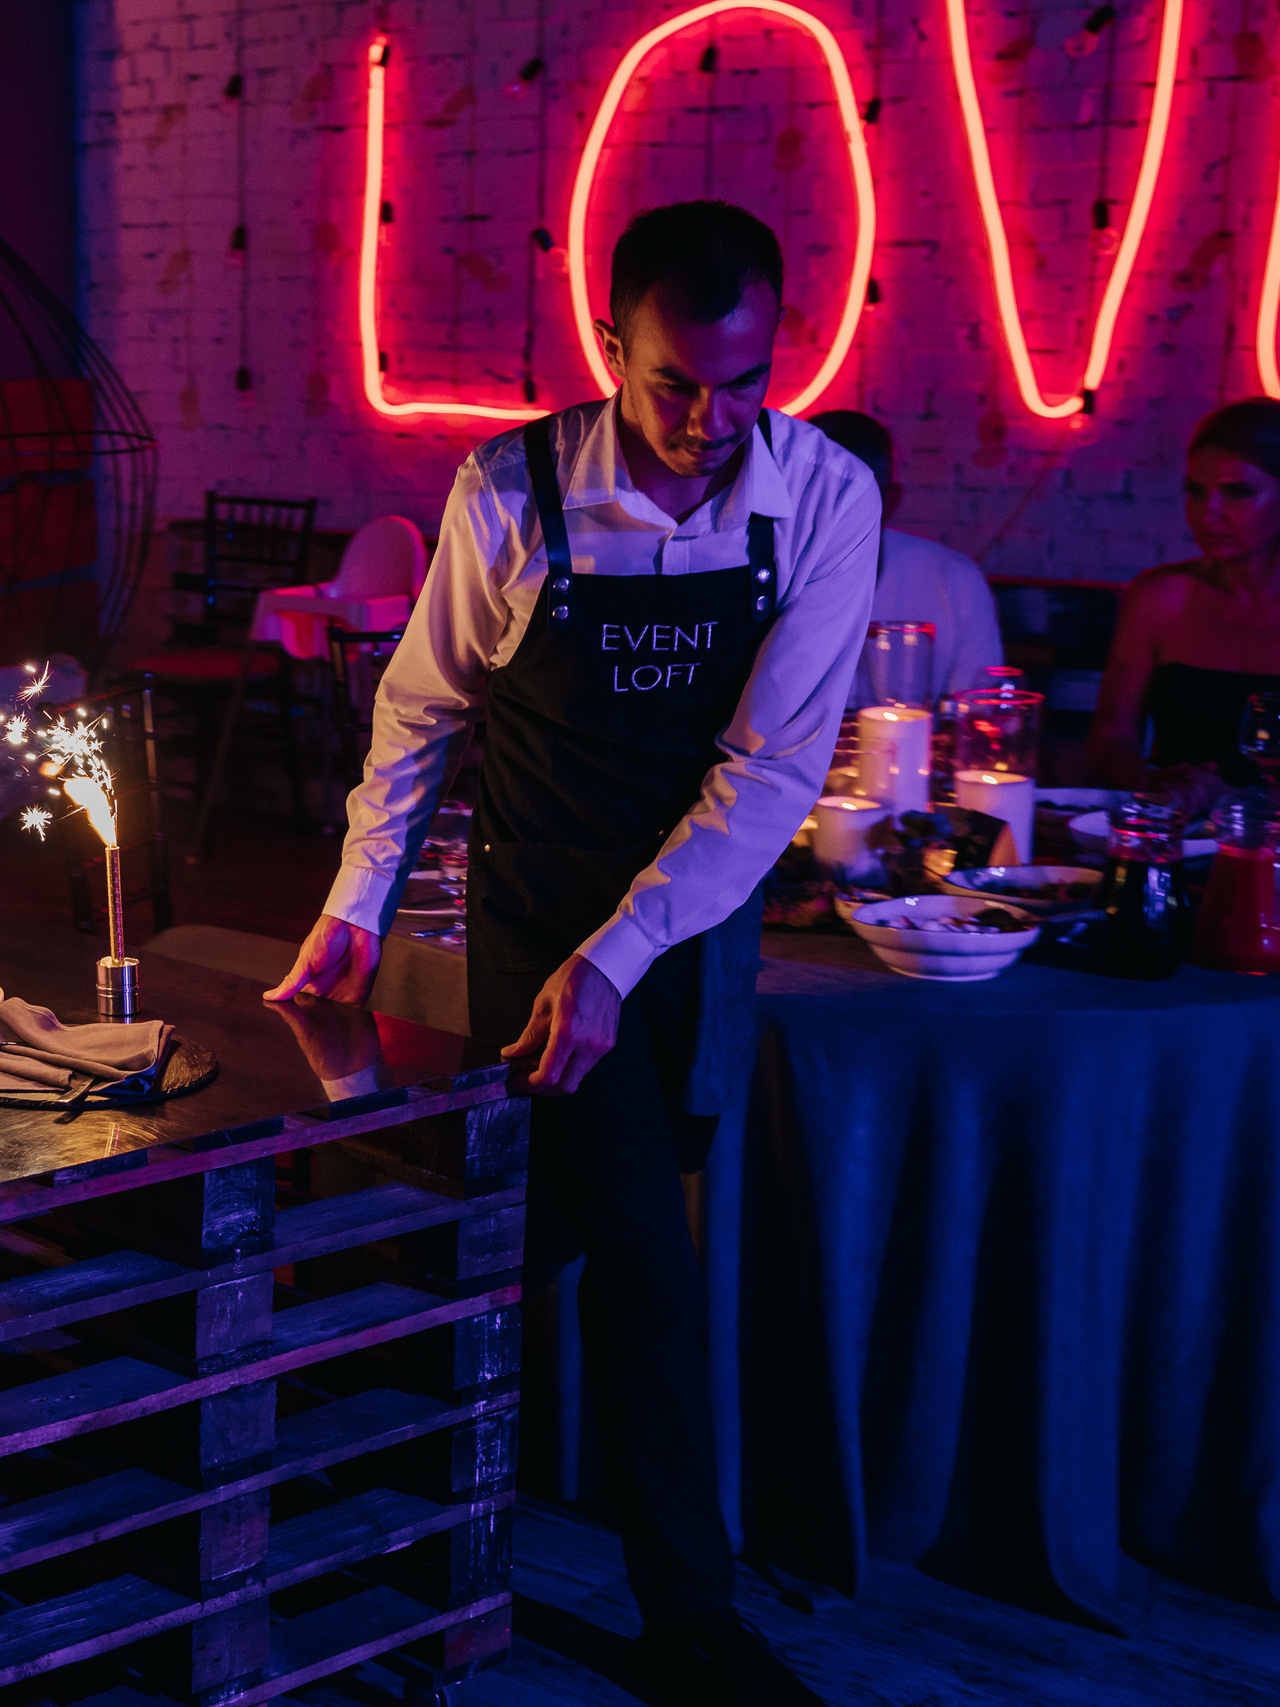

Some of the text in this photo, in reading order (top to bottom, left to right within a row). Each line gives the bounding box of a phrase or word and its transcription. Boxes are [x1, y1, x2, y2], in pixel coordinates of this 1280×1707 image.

[358, 0, 1280, 421] LOV
[601, 621, 719, 652] EVENT
[613, 662, 701, 692] LOFT
